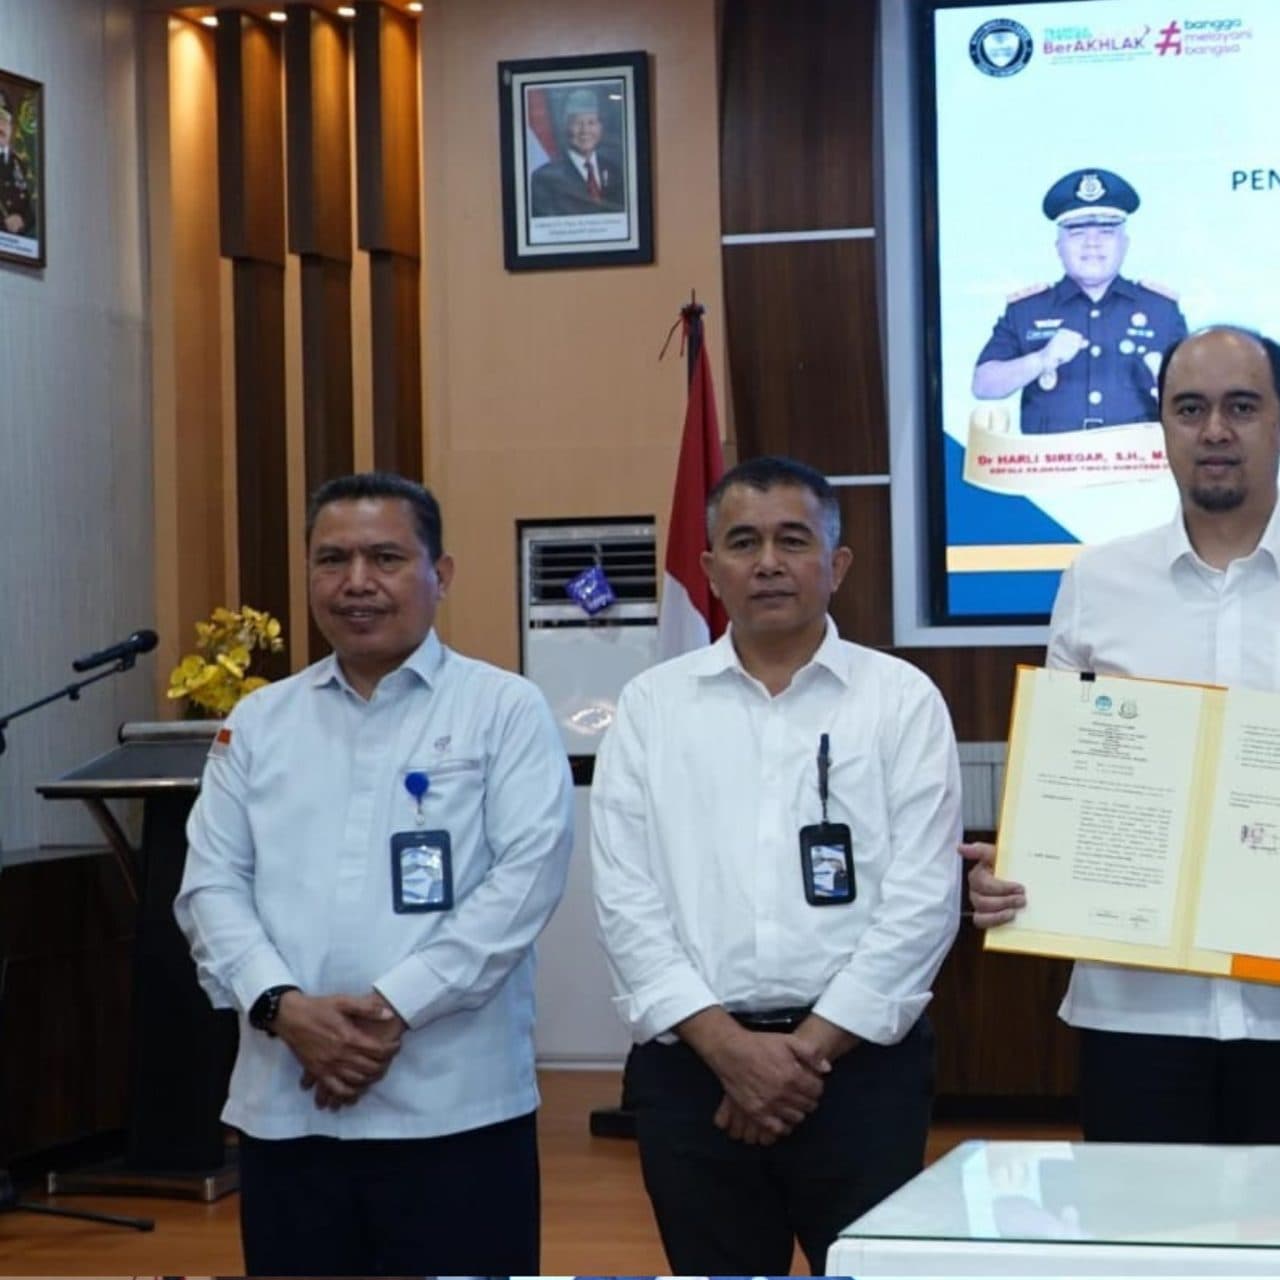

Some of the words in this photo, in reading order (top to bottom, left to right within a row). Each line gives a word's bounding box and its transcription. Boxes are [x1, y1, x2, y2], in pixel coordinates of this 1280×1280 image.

[1043, 38, 1147, 55] BerAKHLAK
[978, 455, 993, 466] Dr
[998, 452, 1039, 464] HARLI
